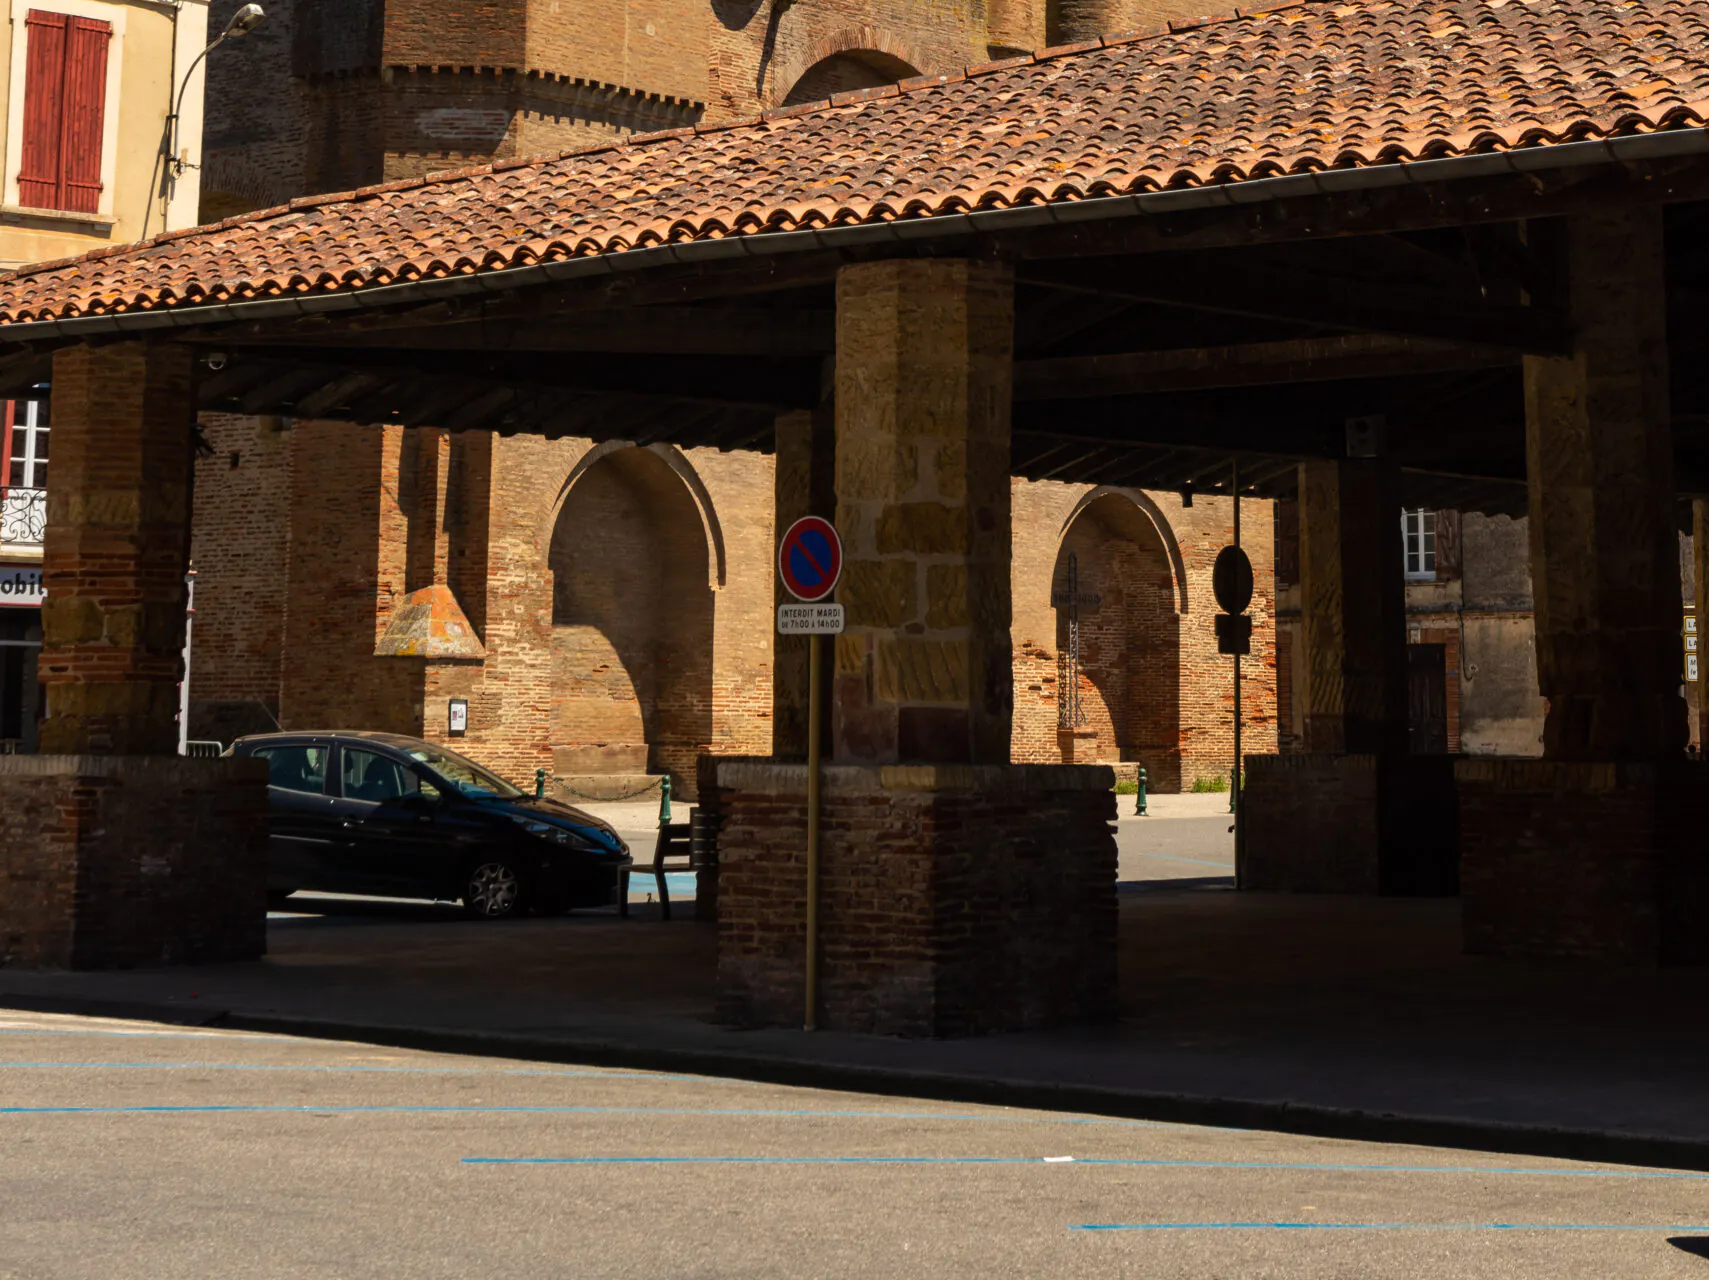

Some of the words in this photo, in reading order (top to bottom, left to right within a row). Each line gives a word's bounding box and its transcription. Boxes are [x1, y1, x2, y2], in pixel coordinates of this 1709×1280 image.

[782, 609, 814, 618] INTERDIT
[817, 609, 841, 618] MARDI
[791, 620, 810, 629] 7h00
[817, 620, 840, 629] 14h00
